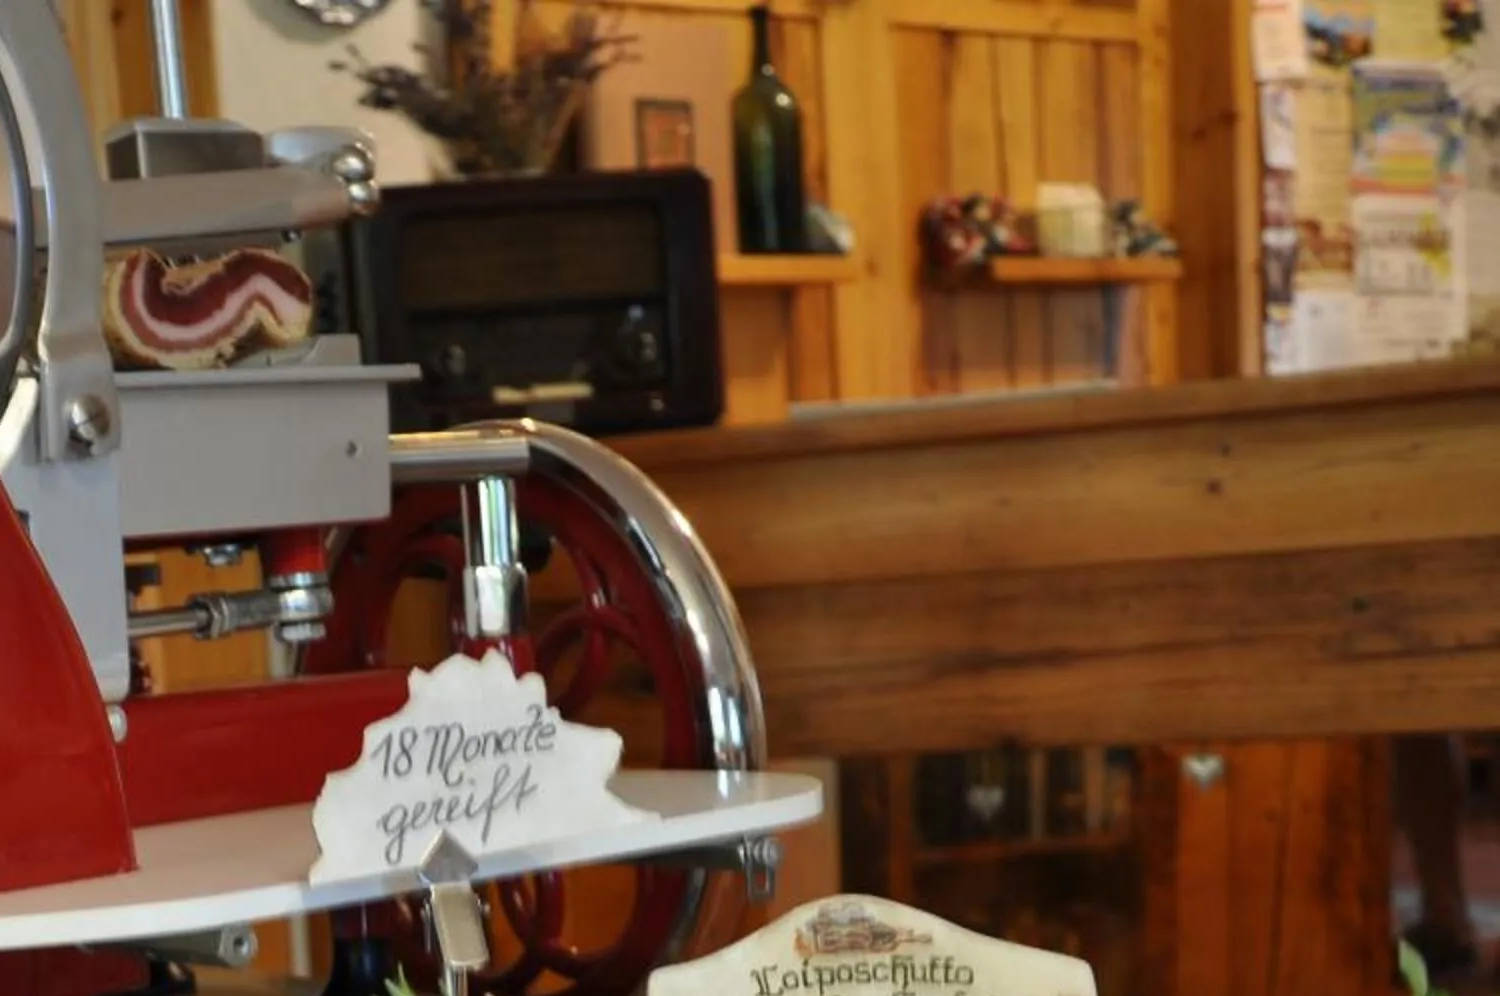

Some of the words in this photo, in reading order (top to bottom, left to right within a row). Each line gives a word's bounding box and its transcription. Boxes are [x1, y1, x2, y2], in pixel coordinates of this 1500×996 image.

[369, 726, 418, 778] 18
[418, 704, 557, 787] Monate
[377, 763, 539, 865] gereift
